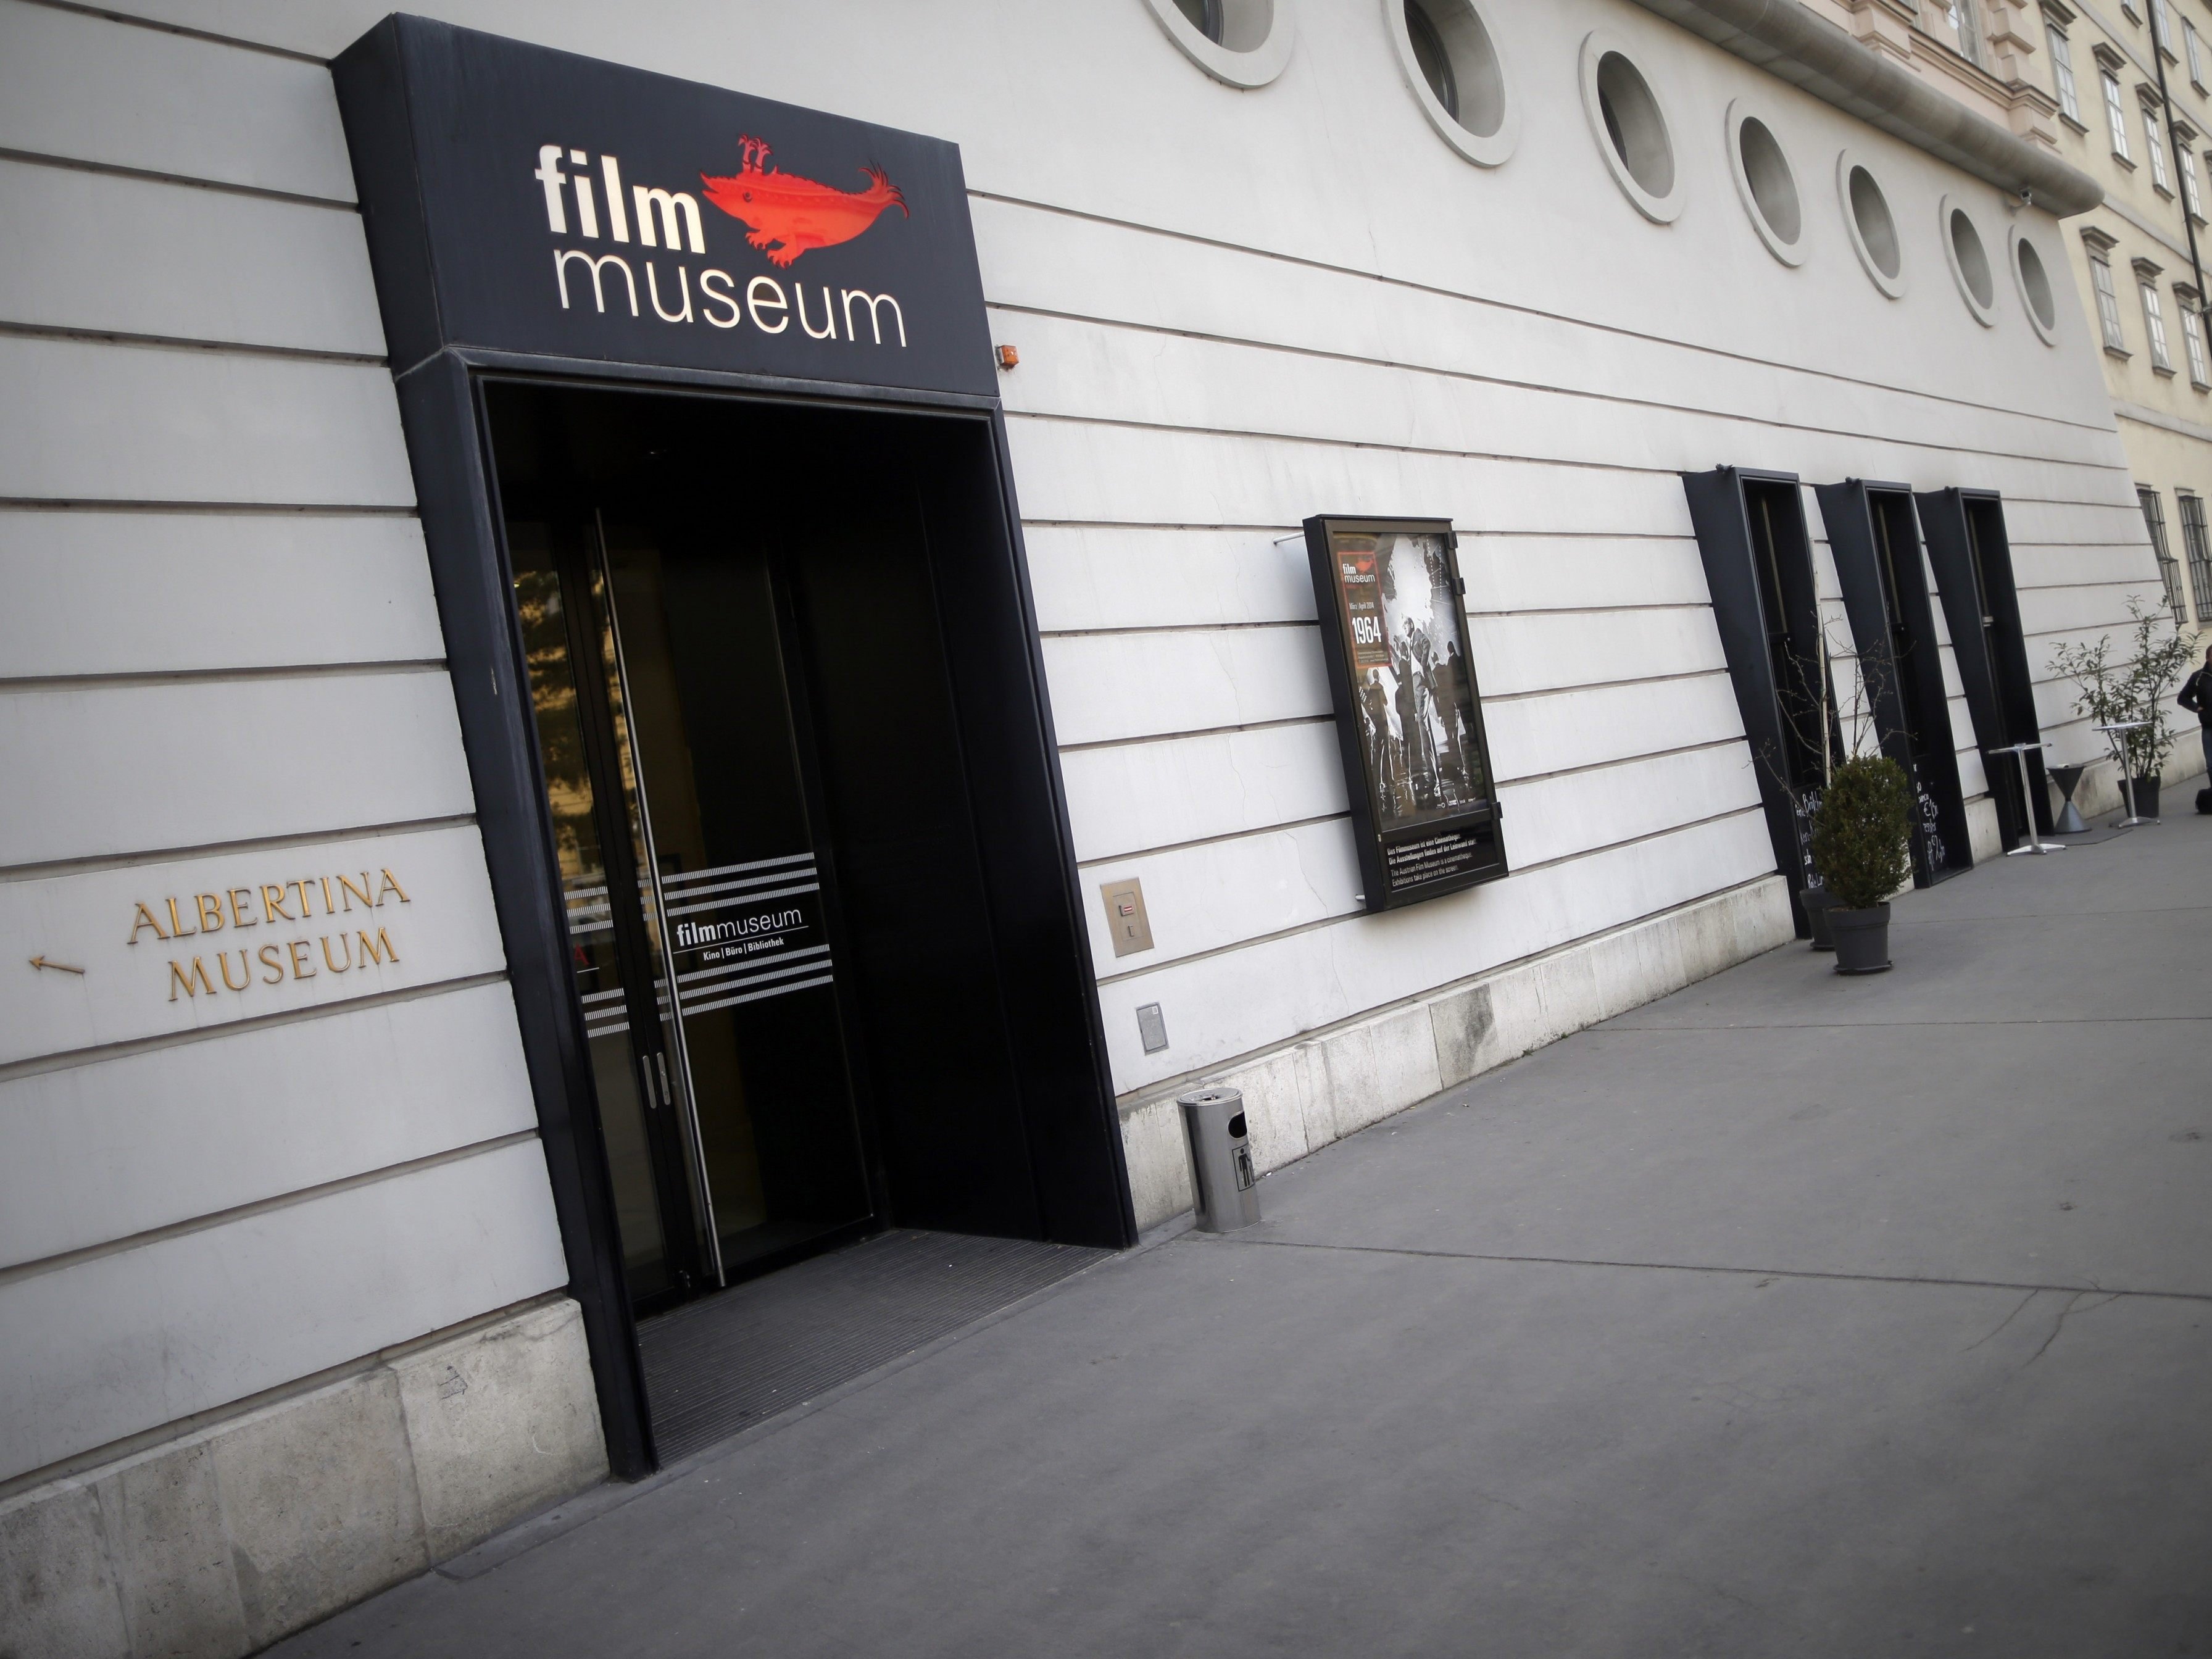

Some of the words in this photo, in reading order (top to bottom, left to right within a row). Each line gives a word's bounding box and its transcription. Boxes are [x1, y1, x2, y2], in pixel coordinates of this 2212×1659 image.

[534, 144, 705, 254] film
[554, 249, 907, 347] museum
[1342, 563, 1357, 575] film
[1344, 574, 1376, 583] museum
[1352, 616, 1381, 644] 1964
[127, 868, 411, 945] ALBERTINA
[676, 909, 802, 947] filmmuseum
[168, 926, 399, 1001] MUSEUM
[703, 952, 720, 961] Kino
[725, 946, 742, 957] Büro
[747, 937, 784, 952] Bibliothek
